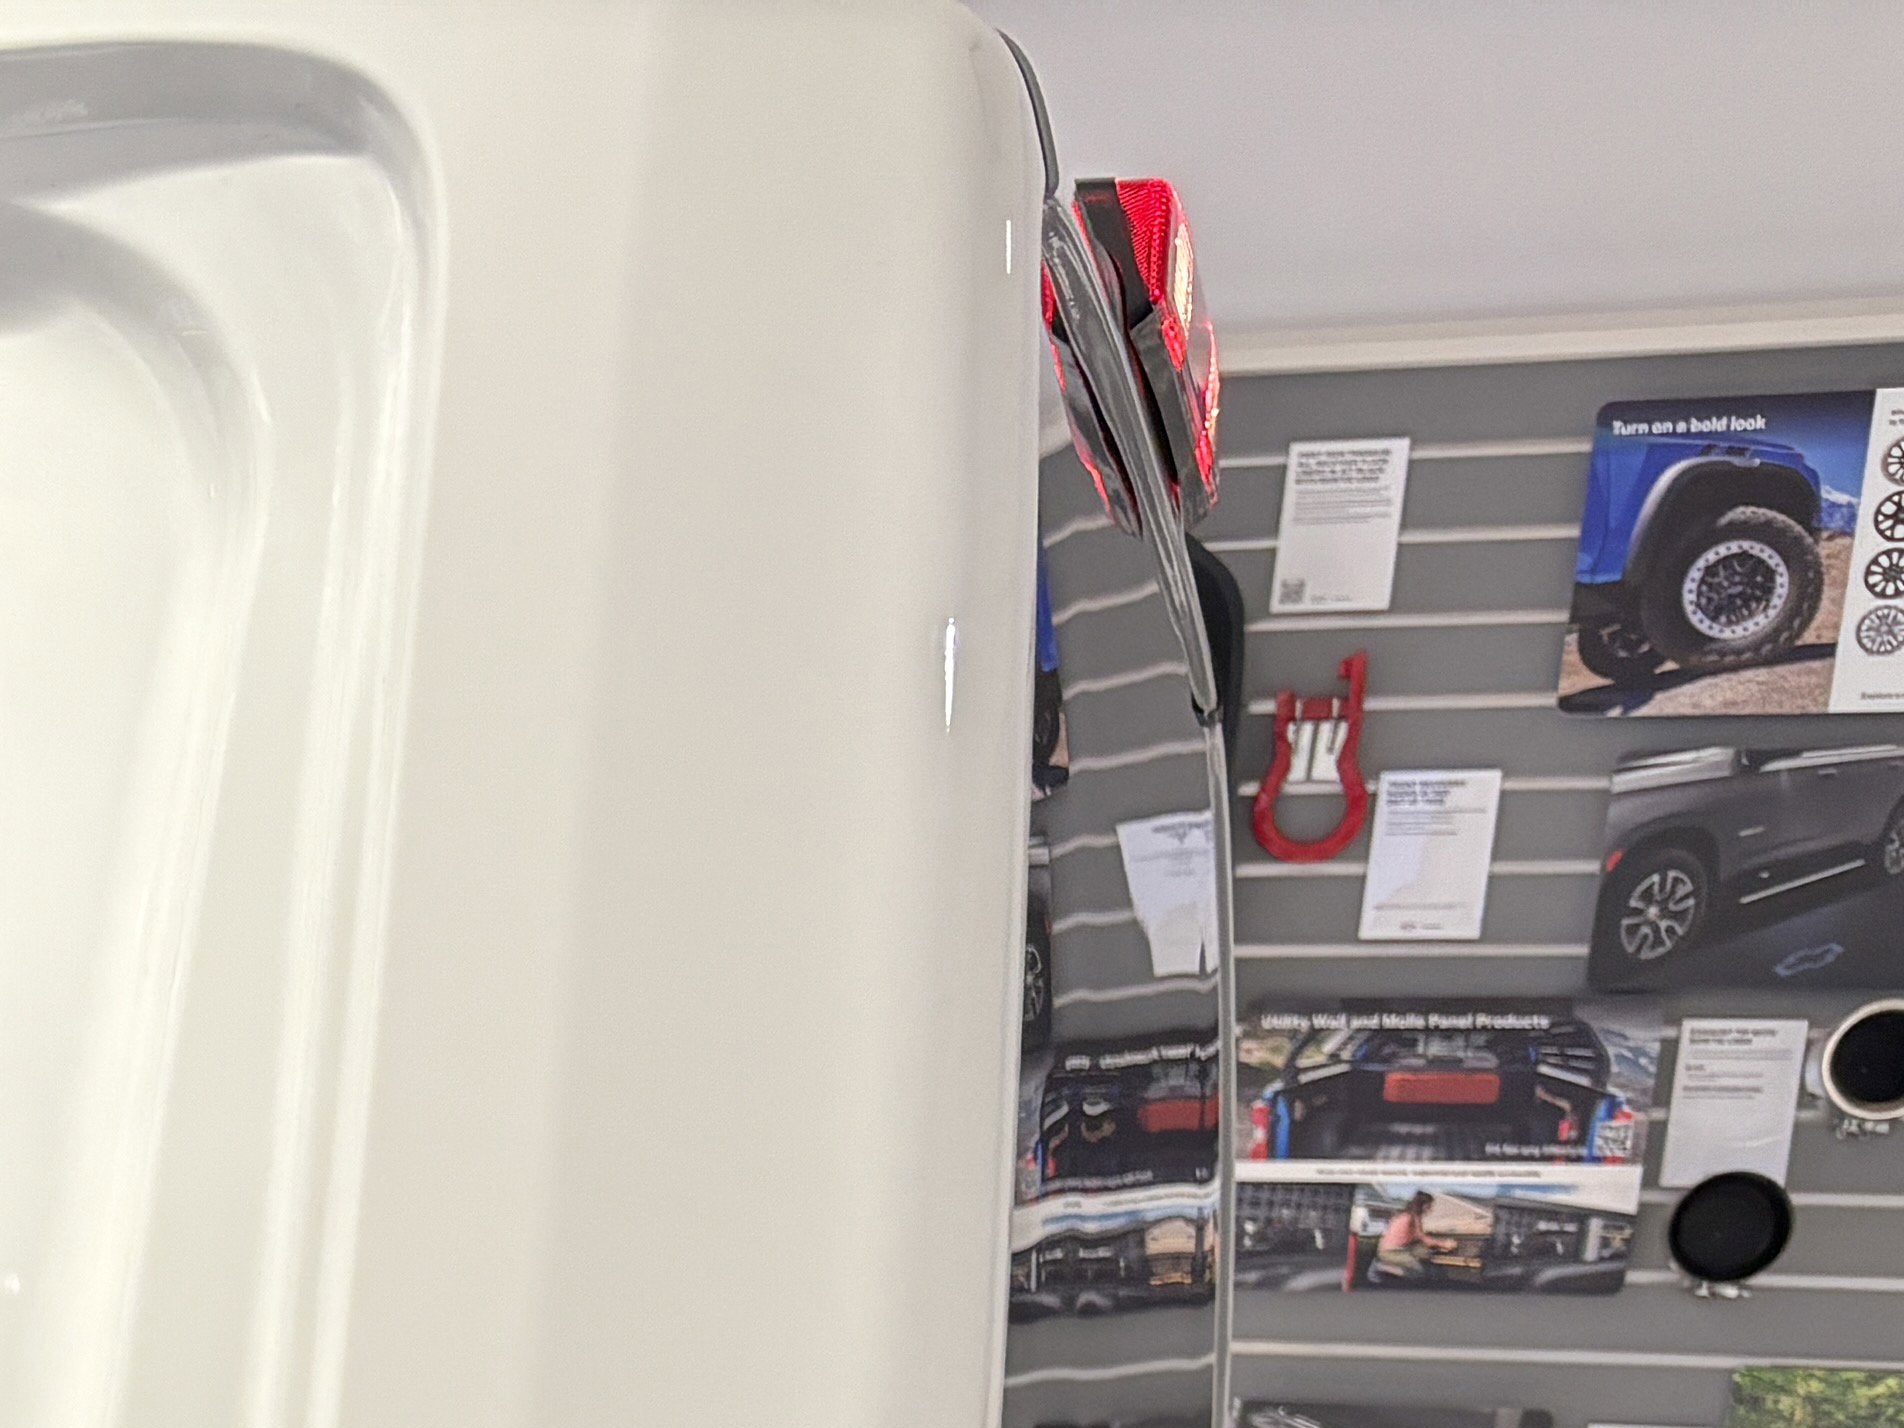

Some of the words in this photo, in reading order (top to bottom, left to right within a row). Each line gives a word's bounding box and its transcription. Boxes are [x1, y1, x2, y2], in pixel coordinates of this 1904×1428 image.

[1613, 420, 1649, 436] Turn
[1652, 419, 1673, 434] on
[1676, 421, 1687, 433] a
[1691, 416, 1728, 432] bold
[1731, 415, 1767, 431] look
[1260, 1013, 1309, 1030] Utility
[1311, 1013, 1347, 1030] Wall
[1350, 1013, 1380, 1029] and
[1382, 1013, 1426, 1030] Molle
[1428, 1013, 1474, 1030] Panel
[1475, 1013, 1550, 1030] Products
